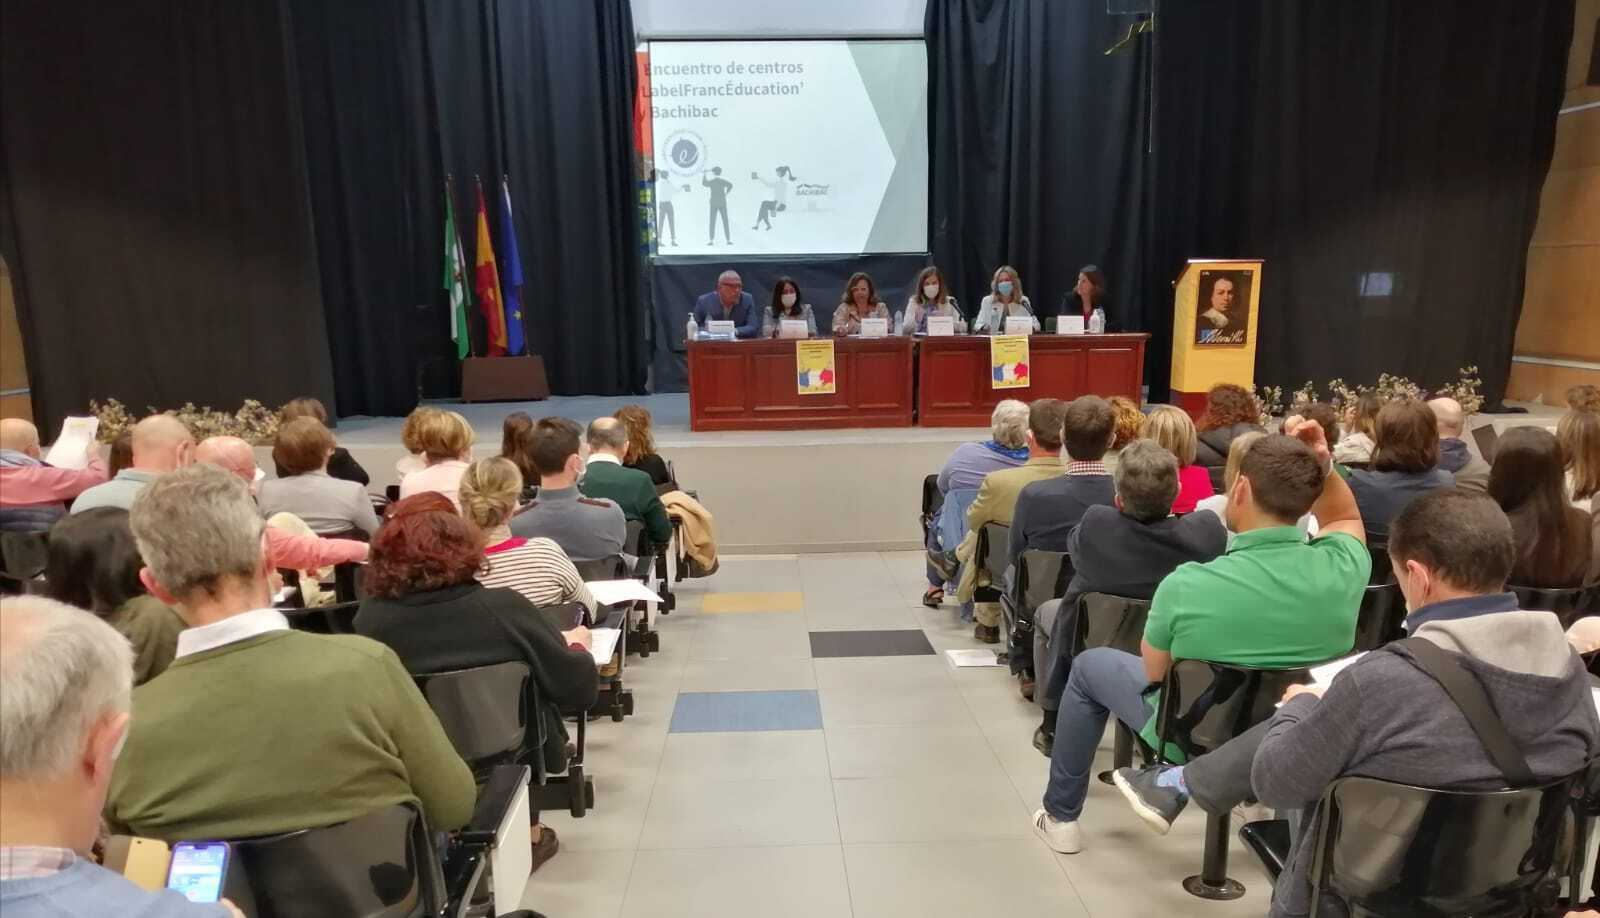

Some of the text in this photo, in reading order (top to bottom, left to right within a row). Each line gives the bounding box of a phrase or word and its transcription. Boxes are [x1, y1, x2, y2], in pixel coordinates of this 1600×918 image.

[643, 60, 804, 77] Encuentro de centros
[650, 104, 720, 120] Bachibac
